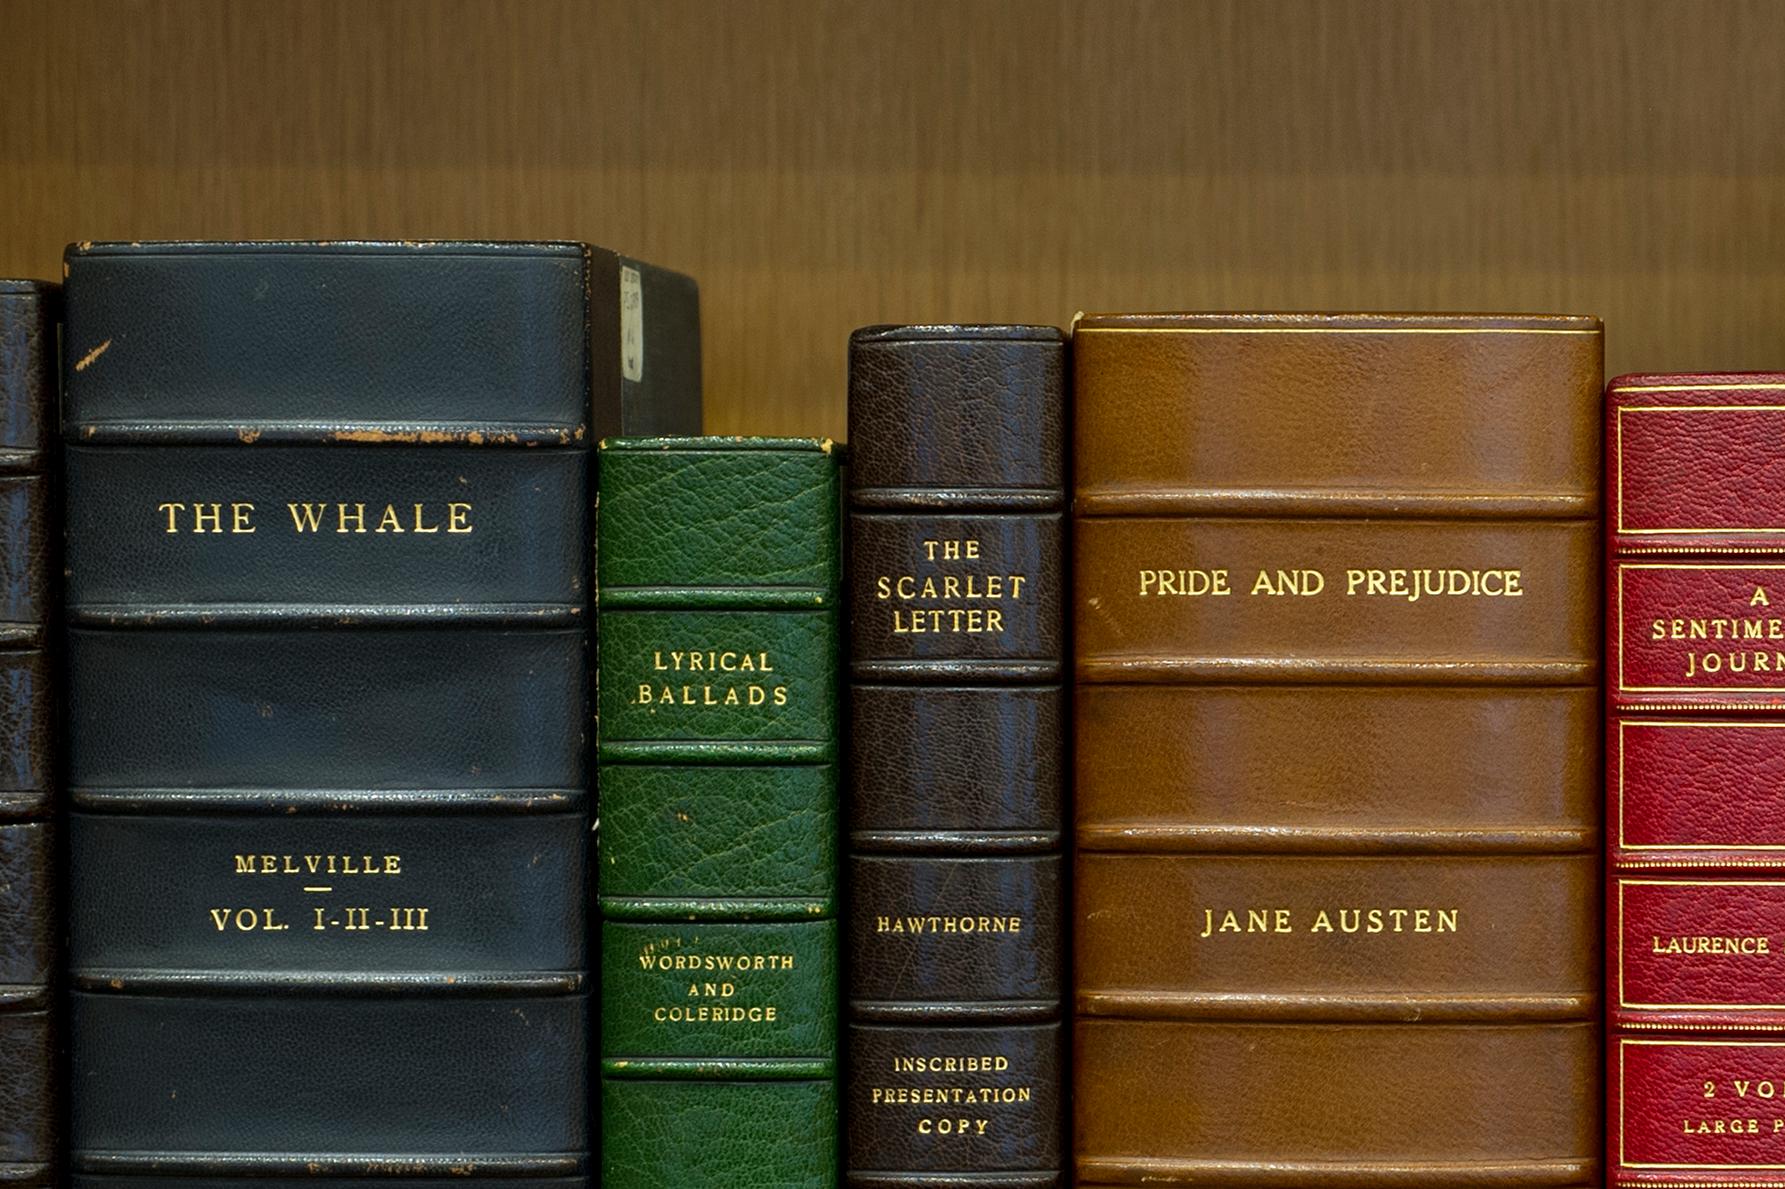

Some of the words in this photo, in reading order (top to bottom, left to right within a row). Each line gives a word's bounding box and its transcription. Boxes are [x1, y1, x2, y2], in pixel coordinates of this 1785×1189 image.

[158, 503, 256, 533] THE
[287, 503, 473, 533] WHALE
[923, 540, 980, 561] THE
[877, 575, 1026, 600] SCARLET
[1139, 569, 1231, 596] PRIDE
[1250, 569, 1325, 596] AND
[1346, 569, 1523, 602] PREJUDICE
[1749, 586, 1770, 607] A
[894, 609, 1004, 633] LETTER
[655, 651, 773, 672] LYRICAL
[639, 684, 787, 706] BALLADS
[235, 855, 401, 874] MELVILLE
[210, 908, 289, 931] VOL.
[314, 908, 429, 931] I-II-III
[877, 916, 1021, 934] HAWTHORNE
[1200, 909, 1292, 938] JANE
[1310, 909, 1458, 933] AUSTEN
[1652, 936, 1770, 955] LAURENCE
[639, 955, 793, 971] WORDSWORTH
[689, 982, 735, 998] AND
[654, 1007, 777, 1022] COLERIDGE
[895, 1056, 1008, 1072] INSCRIBED
[872, 1087, 1030, 1104] PRESENTATION
[1703, 1081, 1715, 1098] 2
[918, 1118, 988, 1135] COPY
[1683, 1119, 1759, 1134] LARGE
